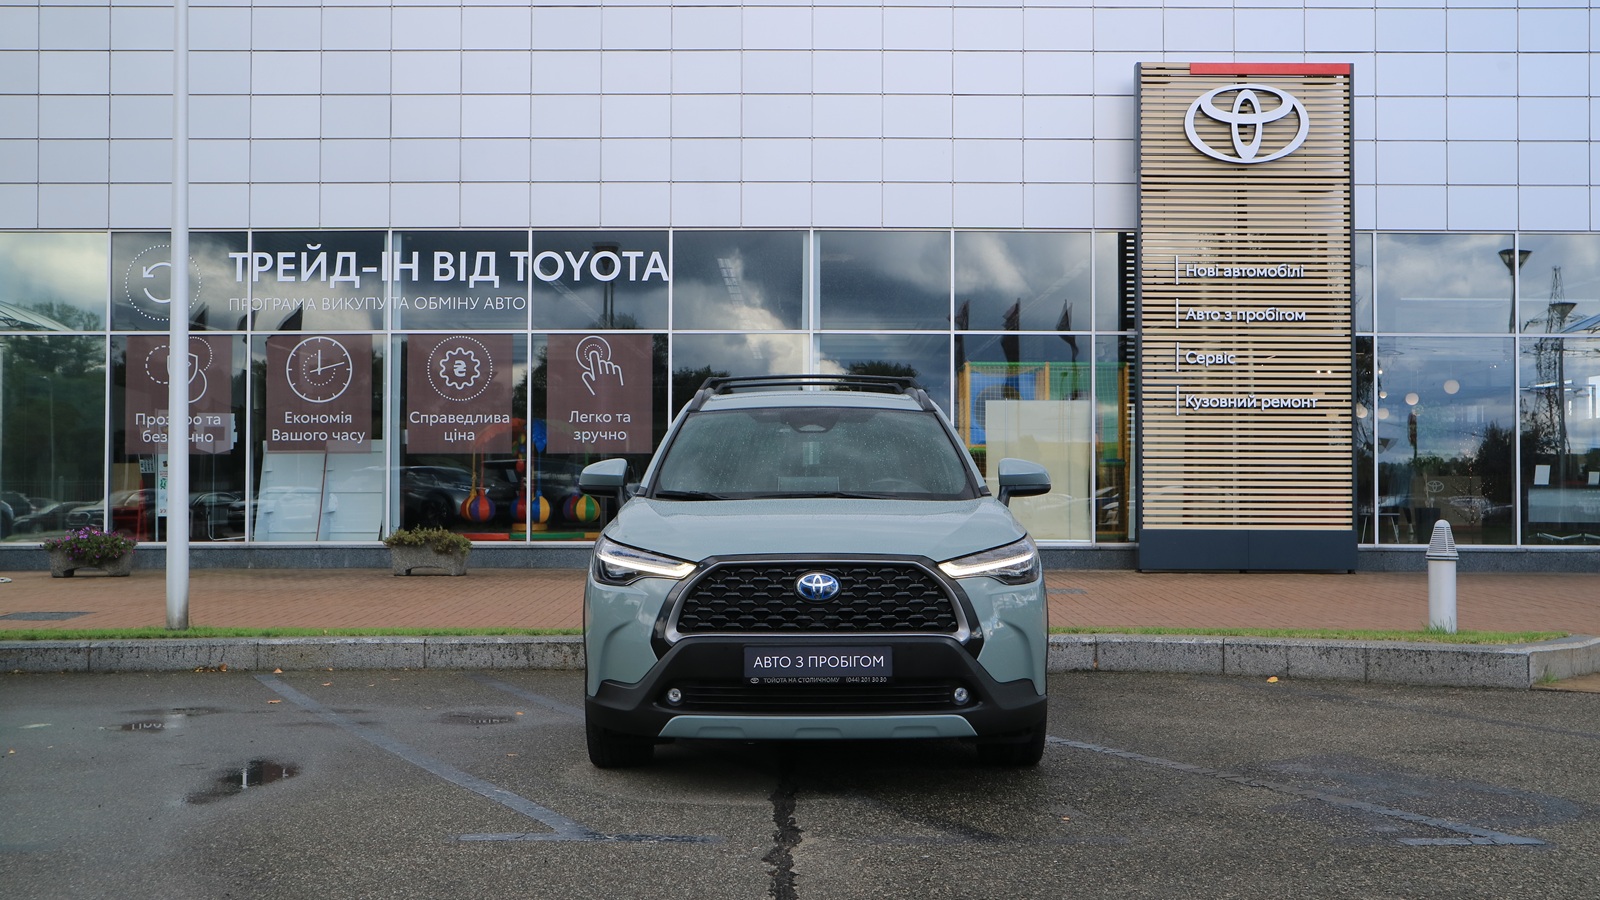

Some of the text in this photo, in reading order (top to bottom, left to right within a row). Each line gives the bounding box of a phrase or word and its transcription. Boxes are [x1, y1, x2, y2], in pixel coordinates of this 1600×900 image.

[228, 243, 669, 289] ТРЕЙД-ІН ВІД TOYOTA
[1186, 264, 1304, 277] Нові автомобілі
[229, 296, 526, 311] ПРОГРАМА ВИКУПУ ТА ОБМІНУ АВТО
[1185, 307, 1306, 324] Авто з пробігом
[1185, 351, 1236, 367] Сервіс
[1185, 394, 1318, 411] Кузовний ремонт
[135, 412, 221, 428] Проо та
[284, 411, 352, 424] Економія
[409, 411, 510, 426] Справедлива
[569, 411, 631, 423] Легко та
[142, 429, 214, 443] безчно
[272, 429, 365, 444] Вашого часу
[444, 428, 475, 443] ціна
[573, 431, 627, 443] зручно
[753, 656, 792, 668] АВТО
[808, 655, 884, 668] ПРОБІГОМ
